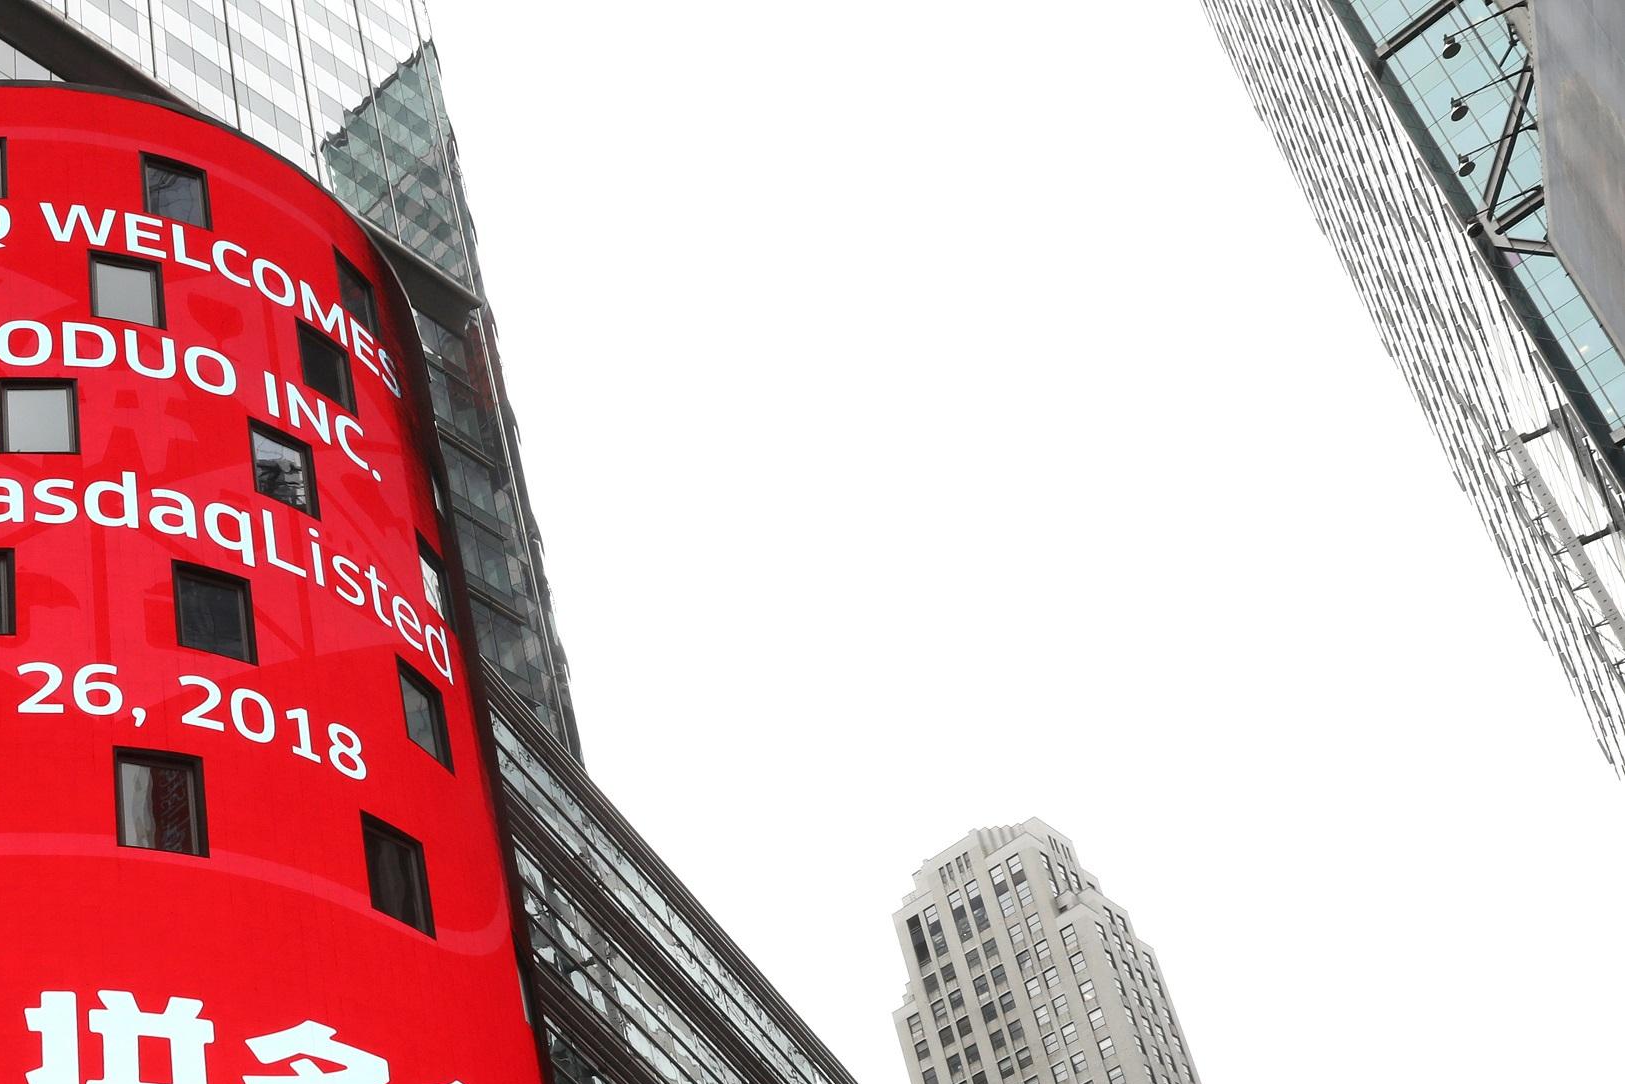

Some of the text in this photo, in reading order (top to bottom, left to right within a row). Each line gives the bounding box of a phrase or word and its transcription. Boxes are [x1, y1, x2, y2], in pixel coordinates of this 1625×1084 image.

[40, 203, 403, 400] WELCOMES
[264, 371, 381, 483] INC.
[17, 662, 146, 727] 26,
[179, 676, 368, 780] 2018
